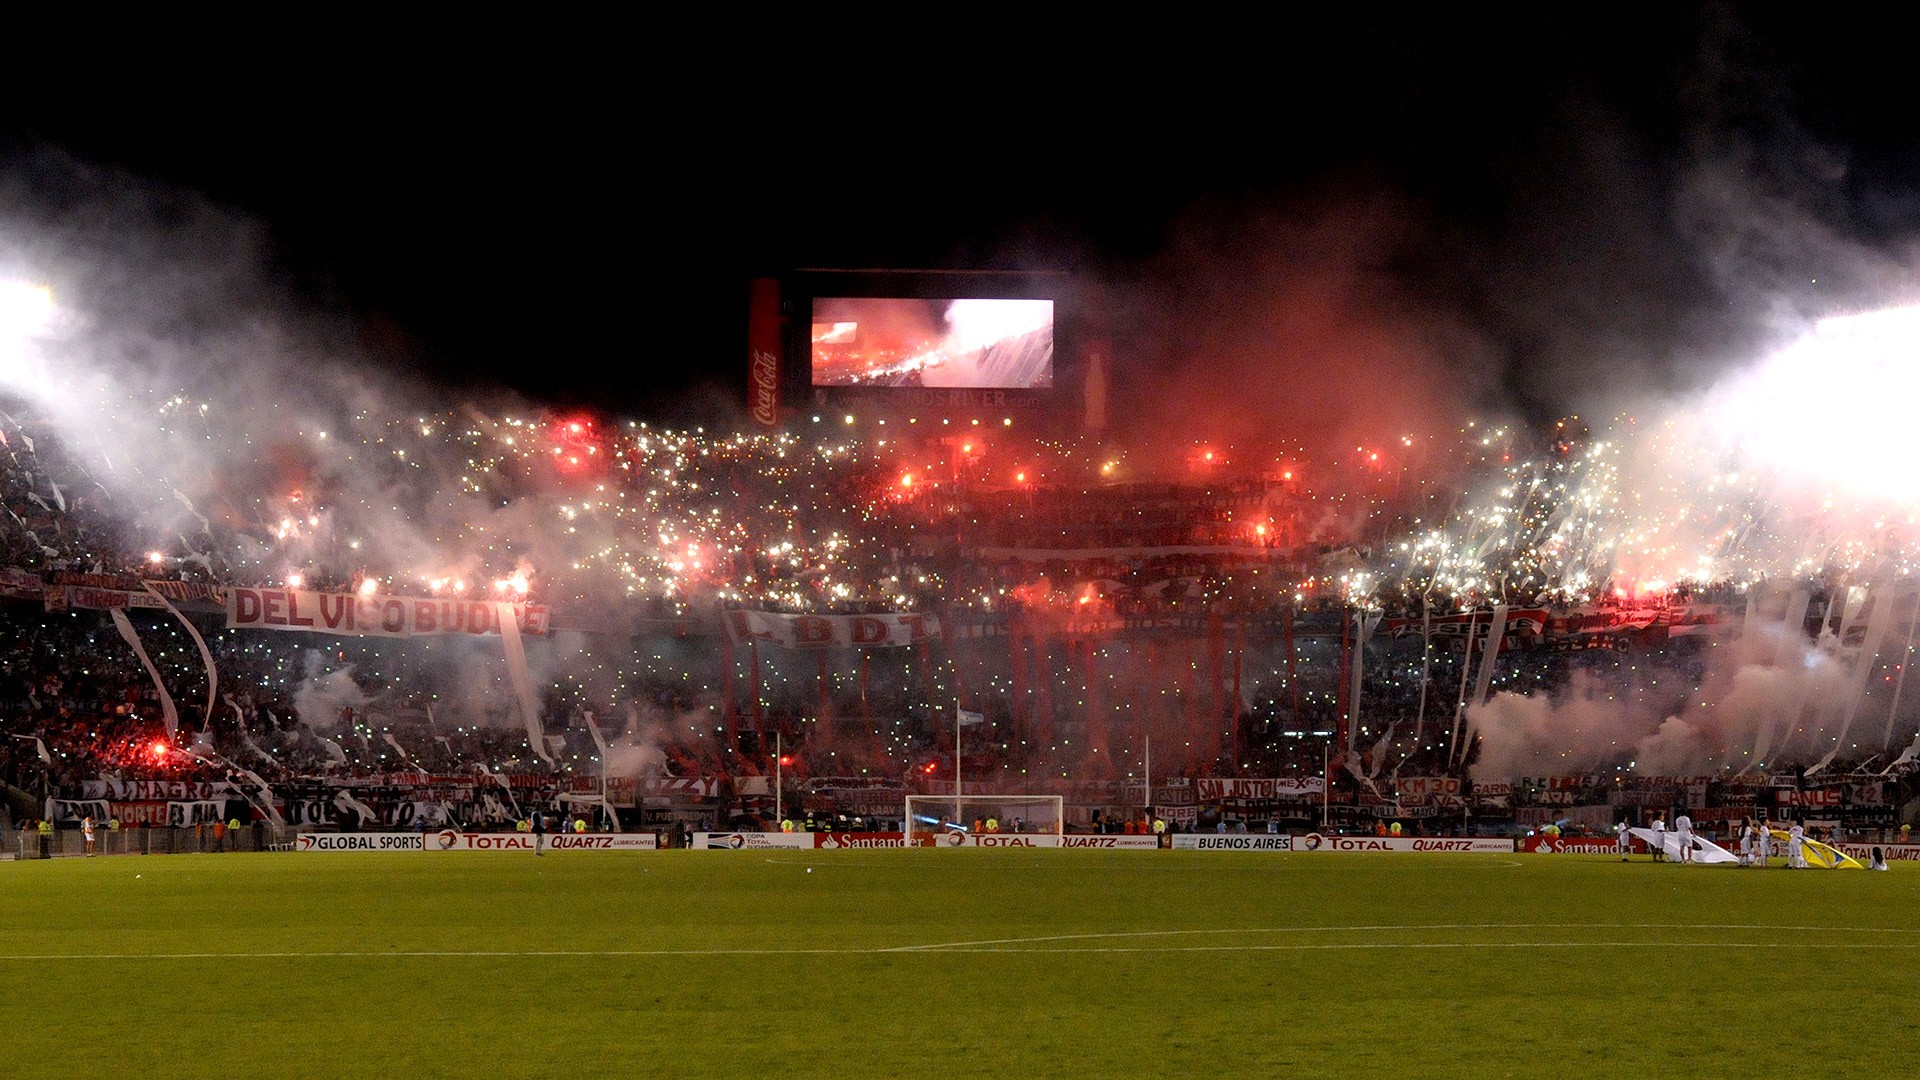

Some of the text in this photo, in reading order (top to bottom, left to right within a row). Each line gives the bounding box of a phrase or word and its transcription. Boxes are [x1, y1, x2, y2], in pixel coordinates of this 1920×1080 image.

[235, 588, 314, 626] DEL
[319, 594, 405, 633] VISO
[1199, 779, 1225, 799] SAN
[1229, 779, 1272, 798] JUSTO
[1397, 779, 1426, 793] KM
[1431, 779, 1459, 793] 30
[1855, 787, 1878, 803] 42
[111, 804, 165, 823] NORTE
[317, 836, 422, 849] GLOBAL SPORTS
[463, 834, 534, 848] TOTAL
[551, 836, 613, 849] QUARTZ
[971, 835, 1036, 848] TOTAL
[1198, 838, 1251, 850] BUENOS
[1253, 838, 1289, 850] AIRES
[1328, 838, 1394, 850] TOTAL
[1412, 839, 1473, 851] QUARTZ
[1839, 845, 1919, 861] TOTAL QUARTZ
